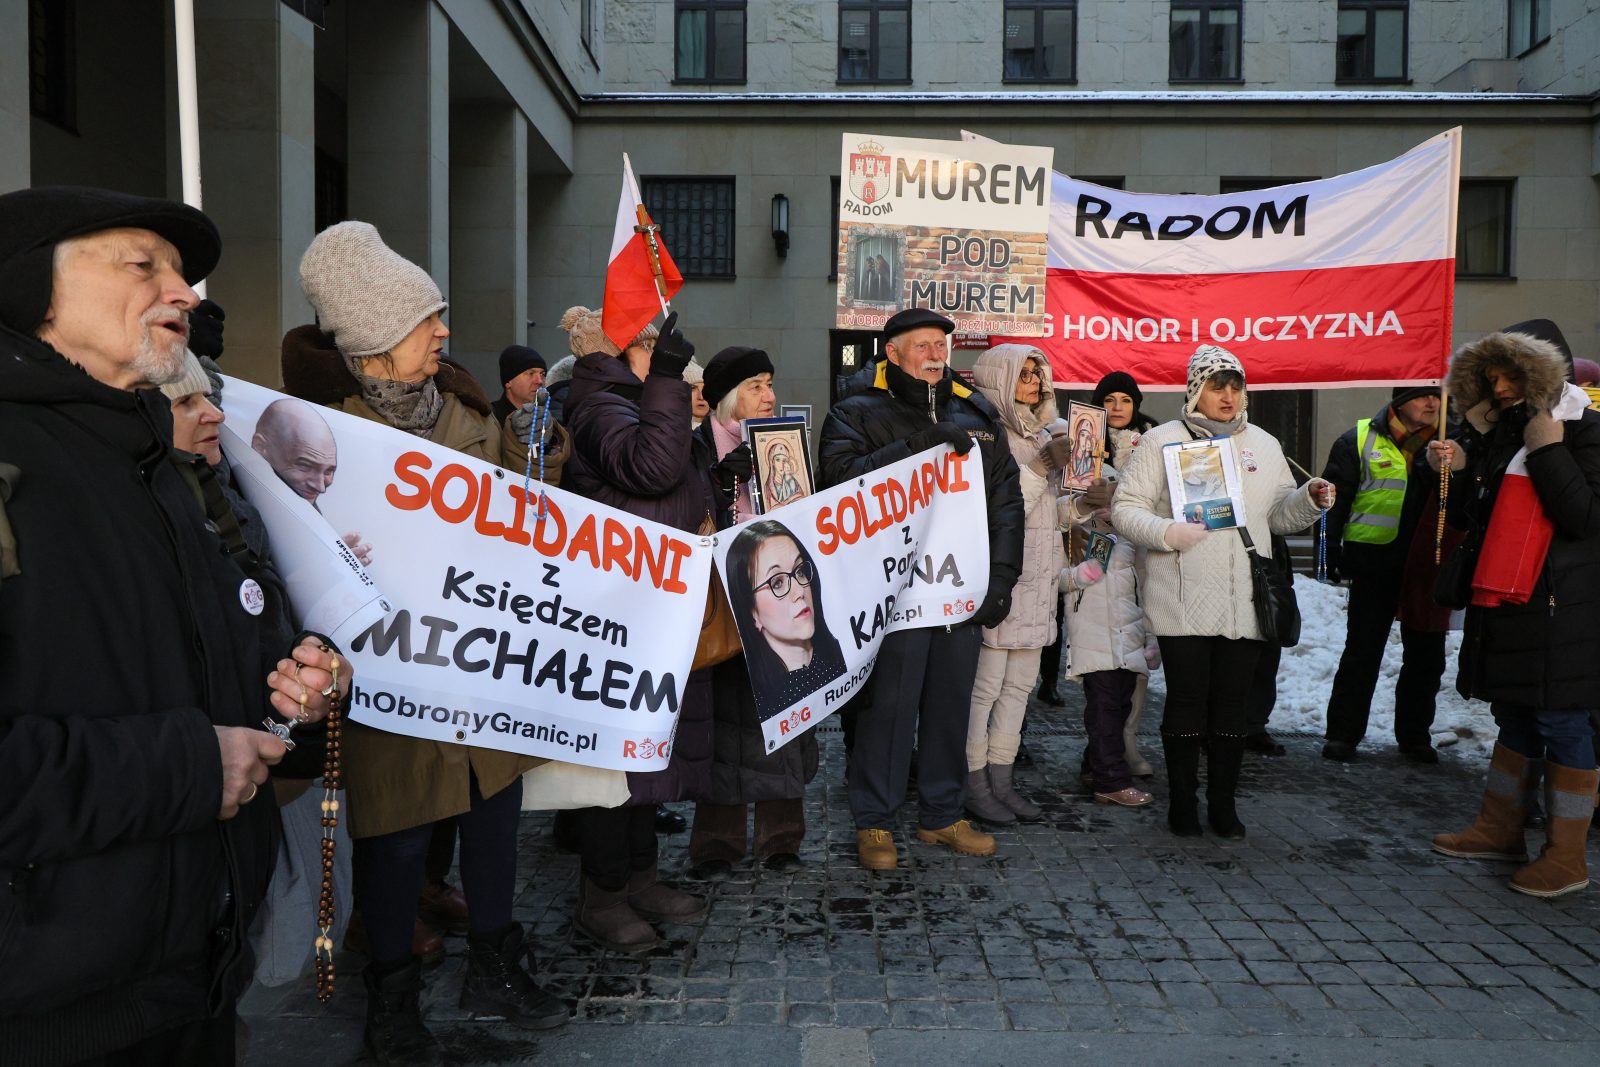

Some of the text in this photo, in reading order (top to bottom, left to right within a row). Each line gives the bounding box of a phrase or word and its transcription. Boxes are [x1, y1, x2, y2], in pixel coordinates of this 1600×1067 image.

[895, 157, 1046, 206] MUREM
[843, 199, 893, 216] RADOM
[1075, 193, 1309, 241] RADOM
[940, 235, 1011, 269] POD
[909, 280, 1036, 314] MUREM
[845, 314, 855, 326] W
[857, 314, 891, 327] OBRO
[961, 318, 1000, 332] REŻIMU
[1002, 320, 1036, 333] TUSKA
[1063, 314, 1180, 343] HONOR
[1191, 317, 1199, 342] I
[1210, 311, 1404, 343] OJCZYZNA
[385, 451, 691, 595] SOLIDARNI
[816, 451, 969, 556] SOLIDARNI
[902, 525, 912, 545] z
[542, 562, 560, 588] z
[442, 565, 628, 648] Księdzem
[351, 609, 678, 713] MICHAŁEM
[354, 685, 598, 753] hObronyGranic.pl
